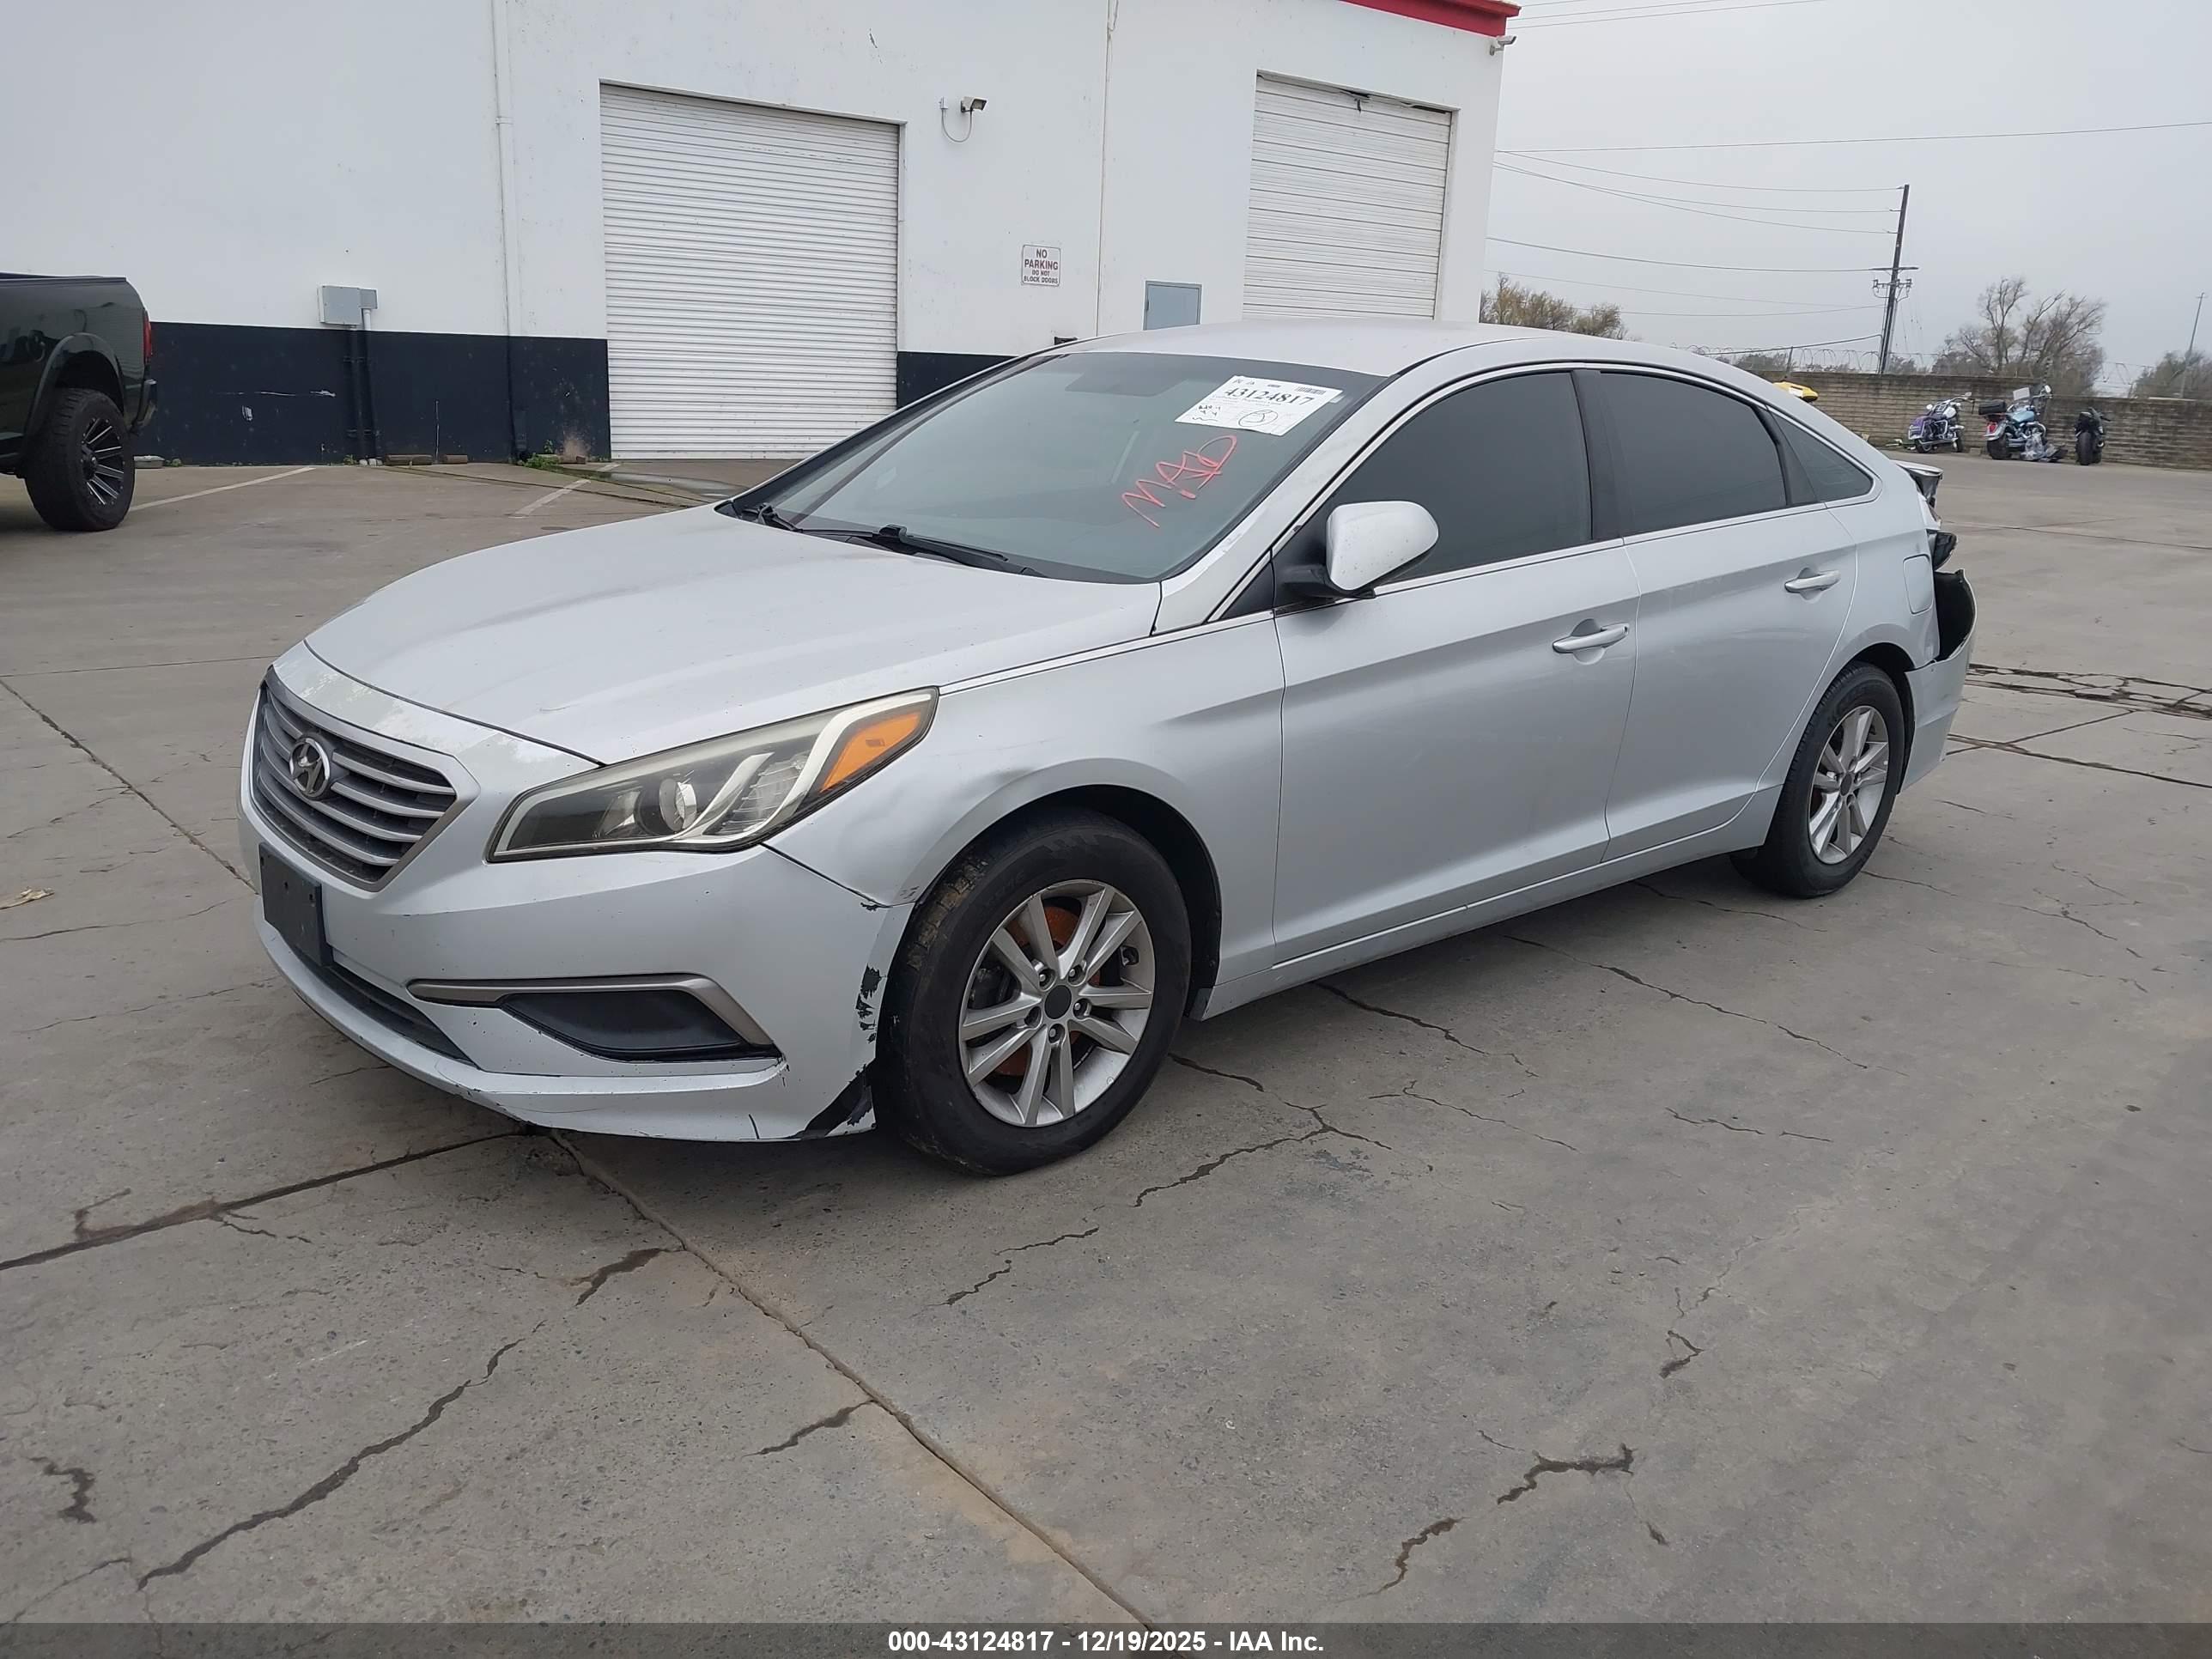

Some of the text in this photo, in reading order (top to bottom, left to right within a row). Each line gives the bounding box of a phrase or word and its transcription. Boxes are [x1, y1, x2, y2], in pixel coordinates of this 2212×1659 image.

[1036, 248, 1047, 258] NO
[1024, 259, 1058, 270] PARKING
[1224, 387, 1315, 405] 43124817
